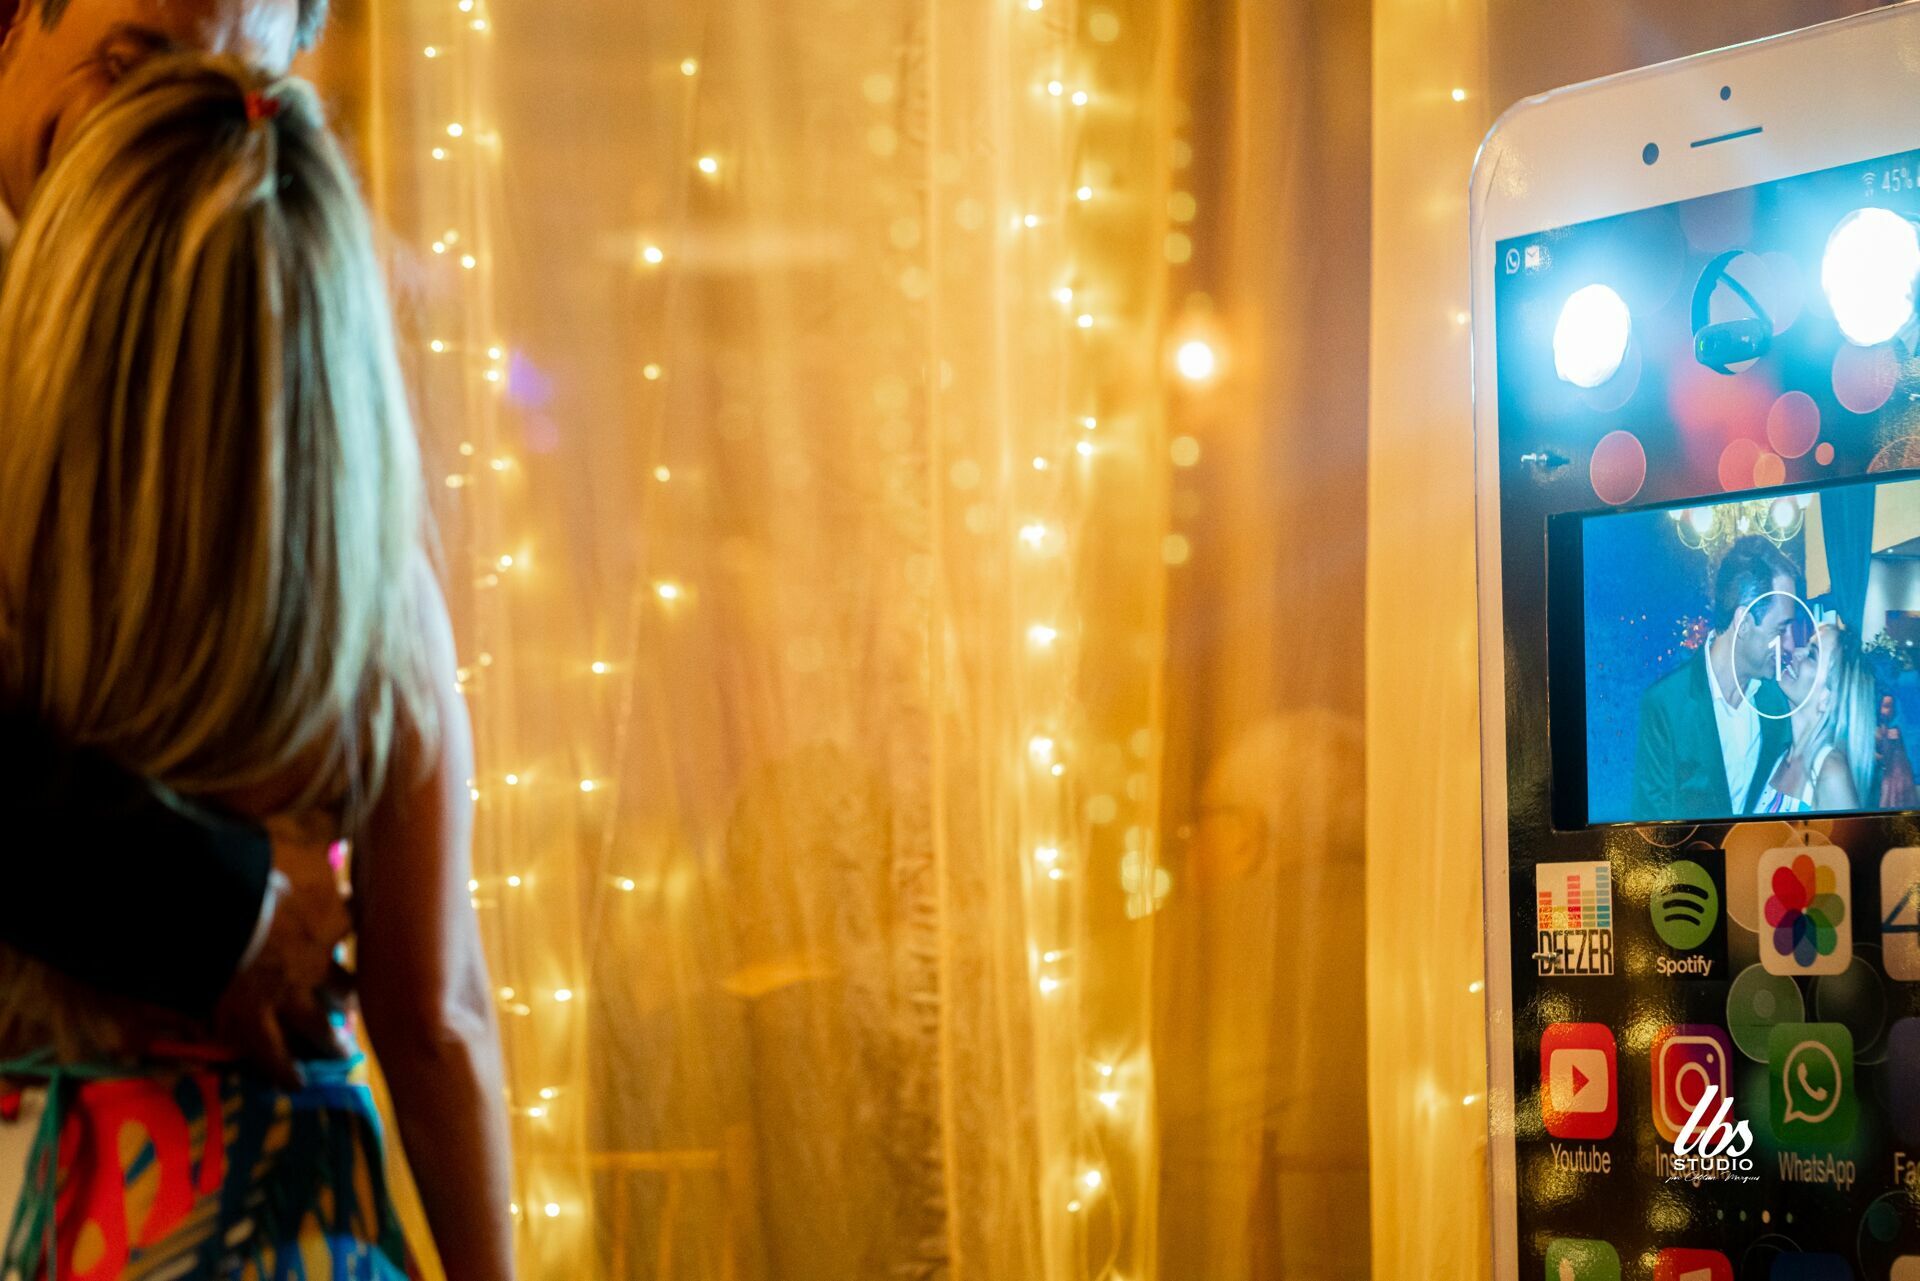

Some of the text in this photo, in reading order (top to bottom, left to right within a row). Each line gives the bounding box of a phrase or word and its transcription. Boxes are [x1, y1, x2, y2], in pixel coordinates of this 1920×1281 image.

[1881, 167, 1913, 193] 45%
[1767, 634, 1781, 682] 1
[1539, 929, 1613, 975] DEEZER
[1656, 954, 1713, 977] Spotify
[1550, 1142, 1612, 1174] Youtube
[1778, 1150, 1856, 1192] WhatsApp
